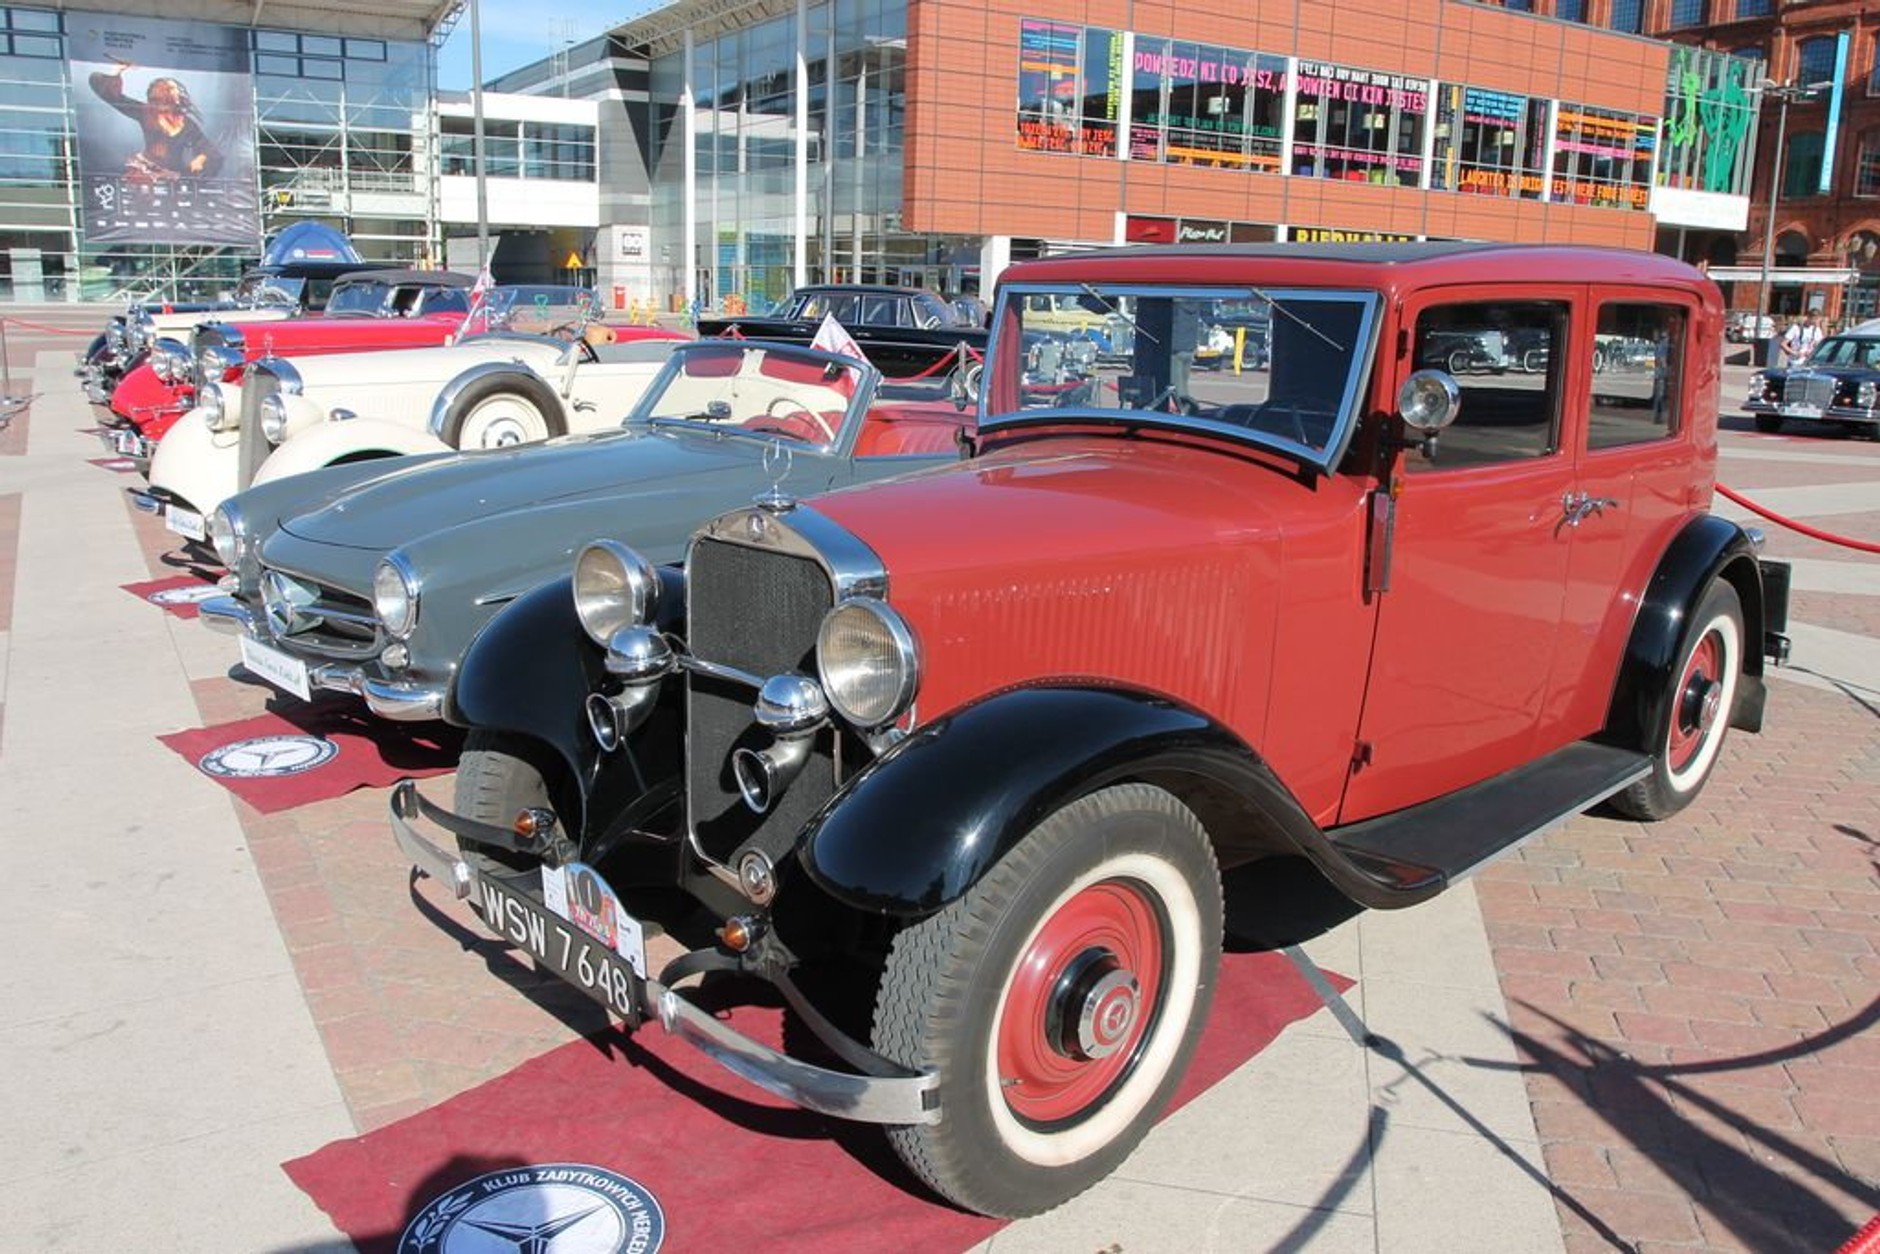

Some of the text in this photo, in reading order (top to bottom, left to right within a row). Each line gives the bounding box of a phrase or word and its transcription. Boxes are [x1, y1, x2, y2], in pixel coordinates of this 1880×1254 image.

[1134, 51, 1196, 79] POWIEDZ
[482, 880, 545, 958] WSW
[556, 926, 630, 1015] 7648
[482, 1173, 530, 1193] KLUB
[536, 1170, 643, 1211] ZABYTKOWYCH
